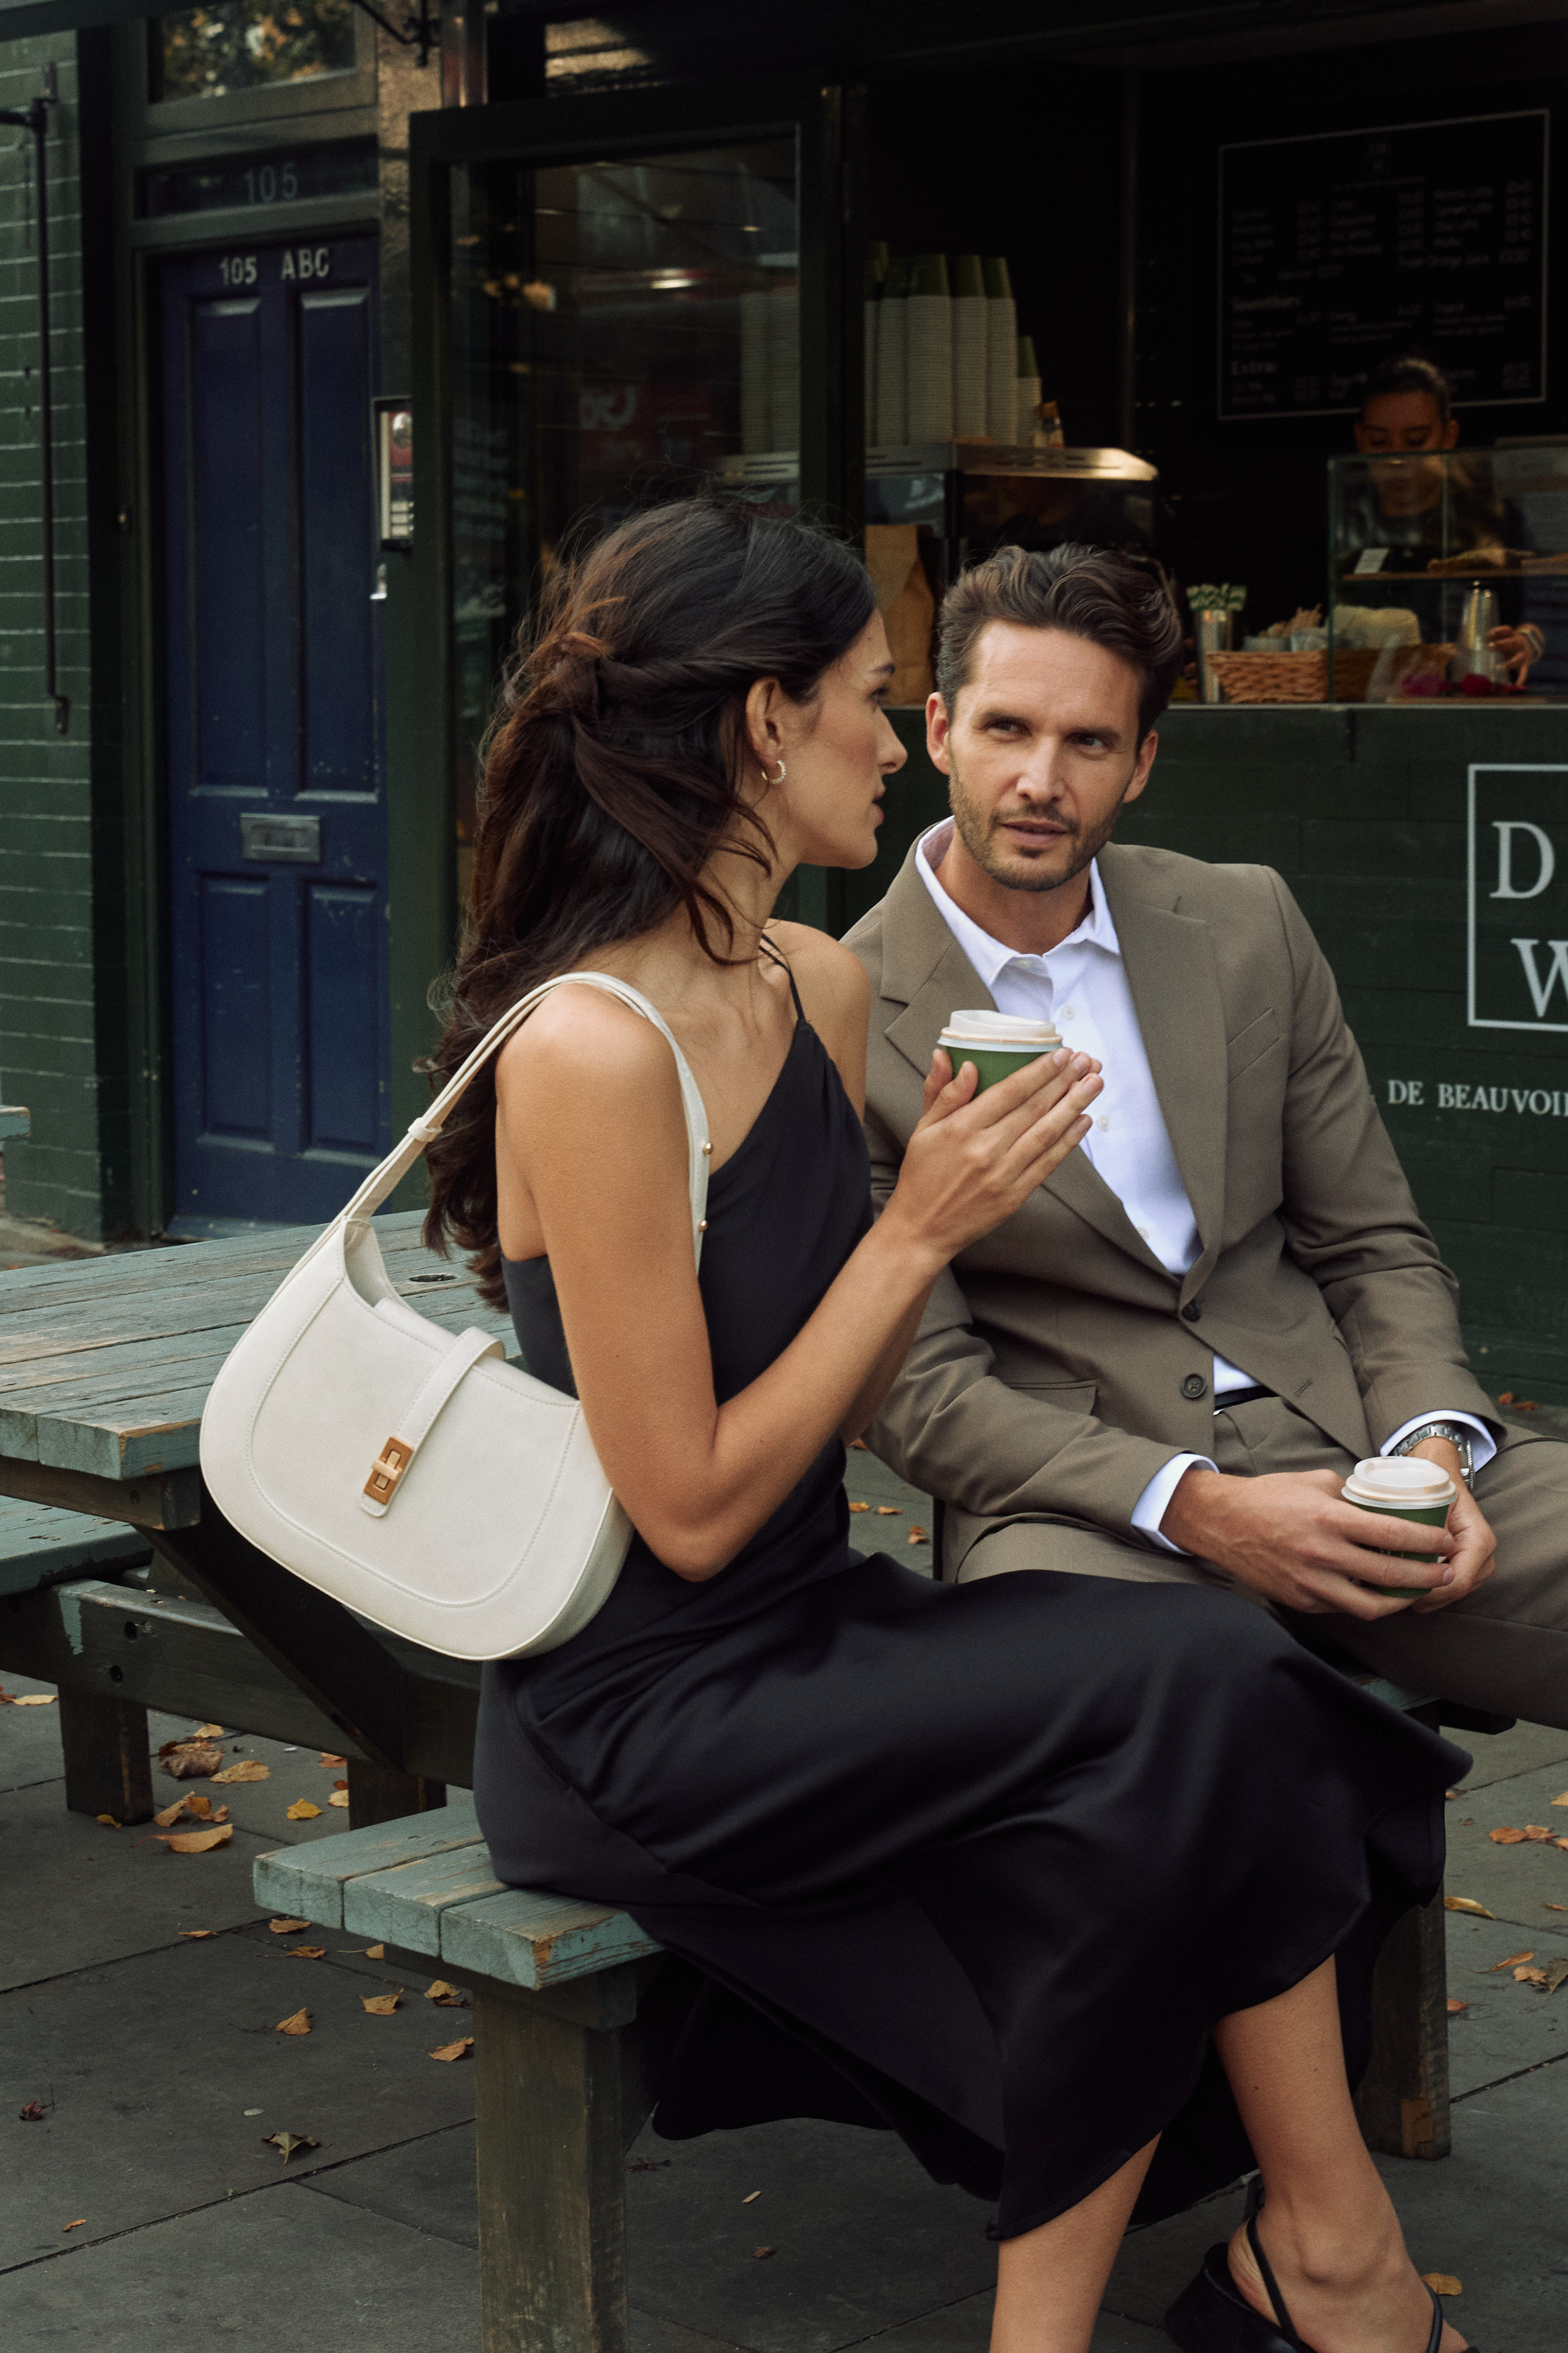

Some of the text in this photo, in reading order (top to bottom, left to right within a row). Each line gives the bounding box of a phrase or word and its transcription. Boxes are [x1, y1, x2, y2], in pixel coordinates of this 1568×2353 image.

[244, 161, 298, 202] 105
[218, 247, 329, 286] 105 ABC
[1489, 821, 1556, 899] D
[1387, 1078, 1425, 1106] DE
